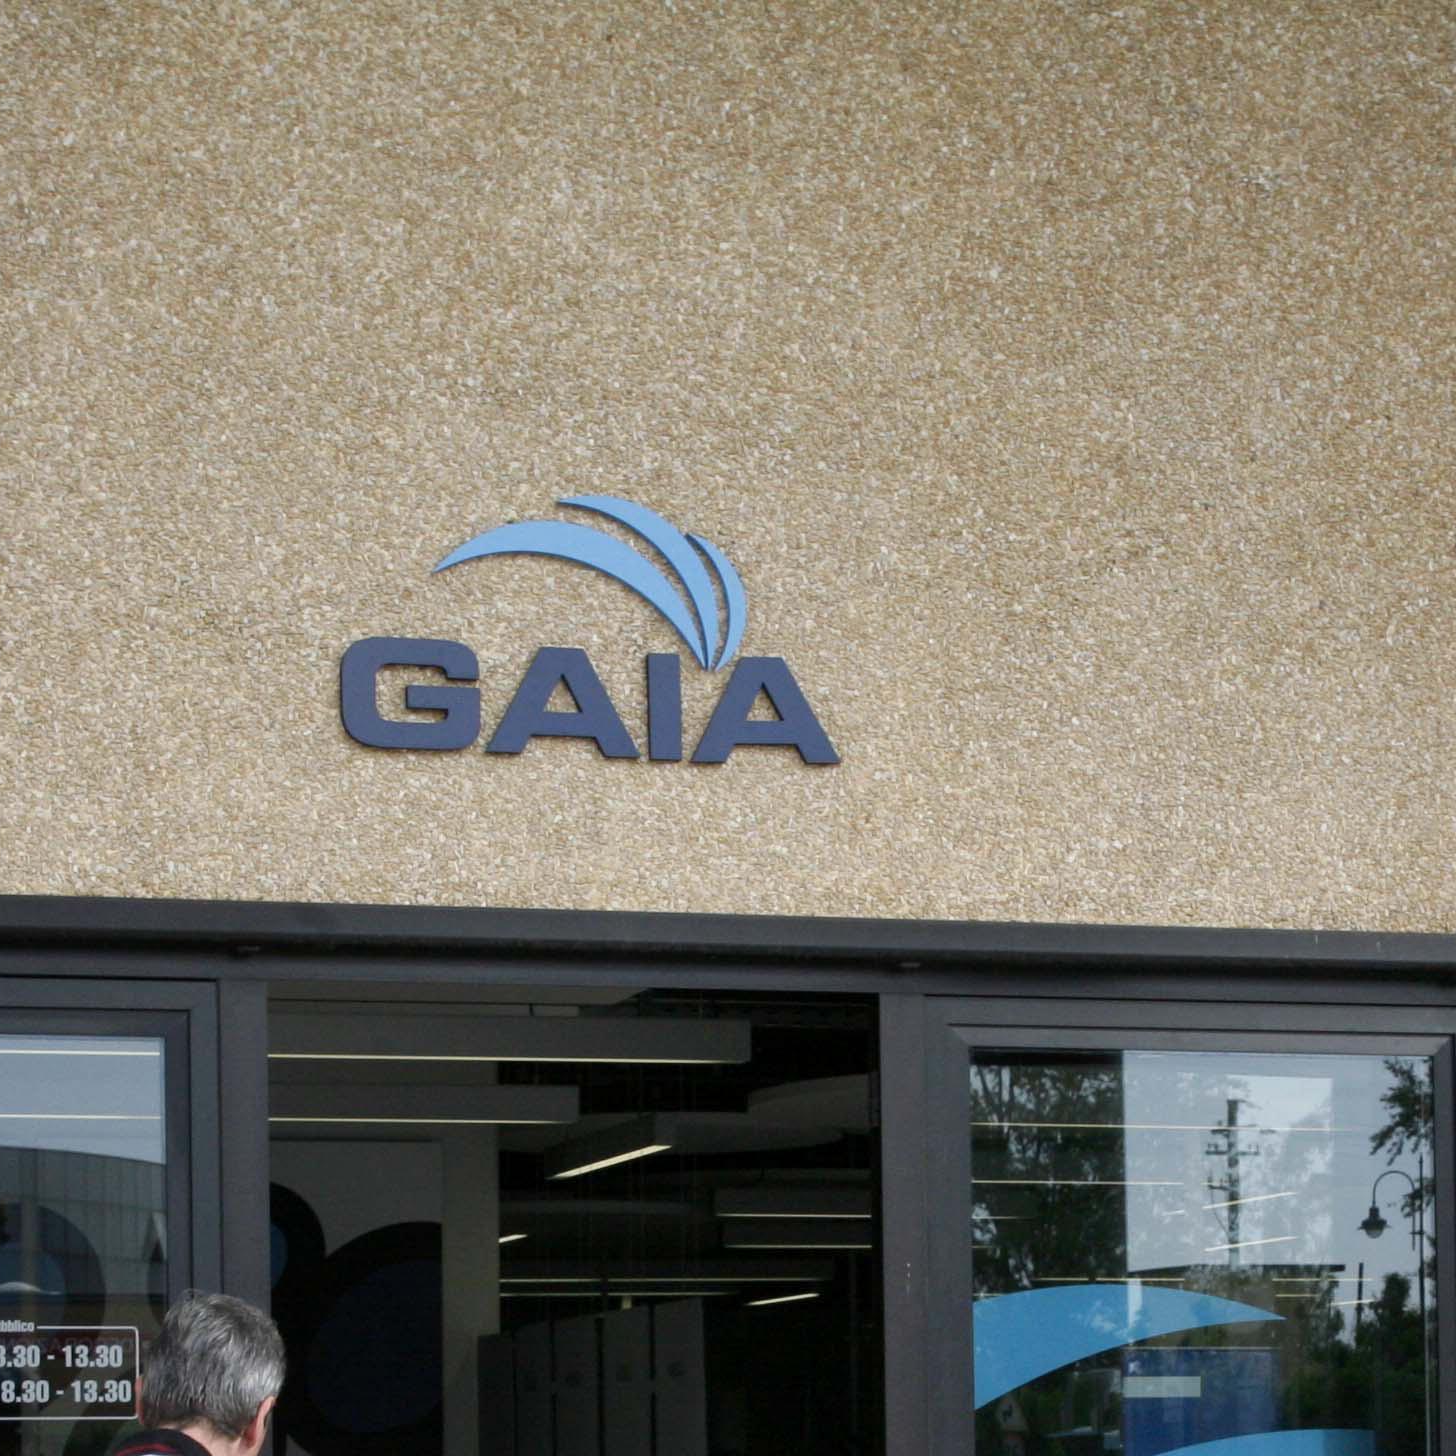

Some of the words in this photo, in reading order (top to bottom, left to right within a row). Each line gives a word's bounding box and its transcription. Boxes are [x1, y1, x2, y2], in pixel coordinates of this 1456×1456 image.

[340, 636, 841, 764] GAIA
[62, 1344, 123, 1368] 13.30
[1, 1380, 50, 1404] 8.30
[70, 1379, 132, 1404] 13.30
